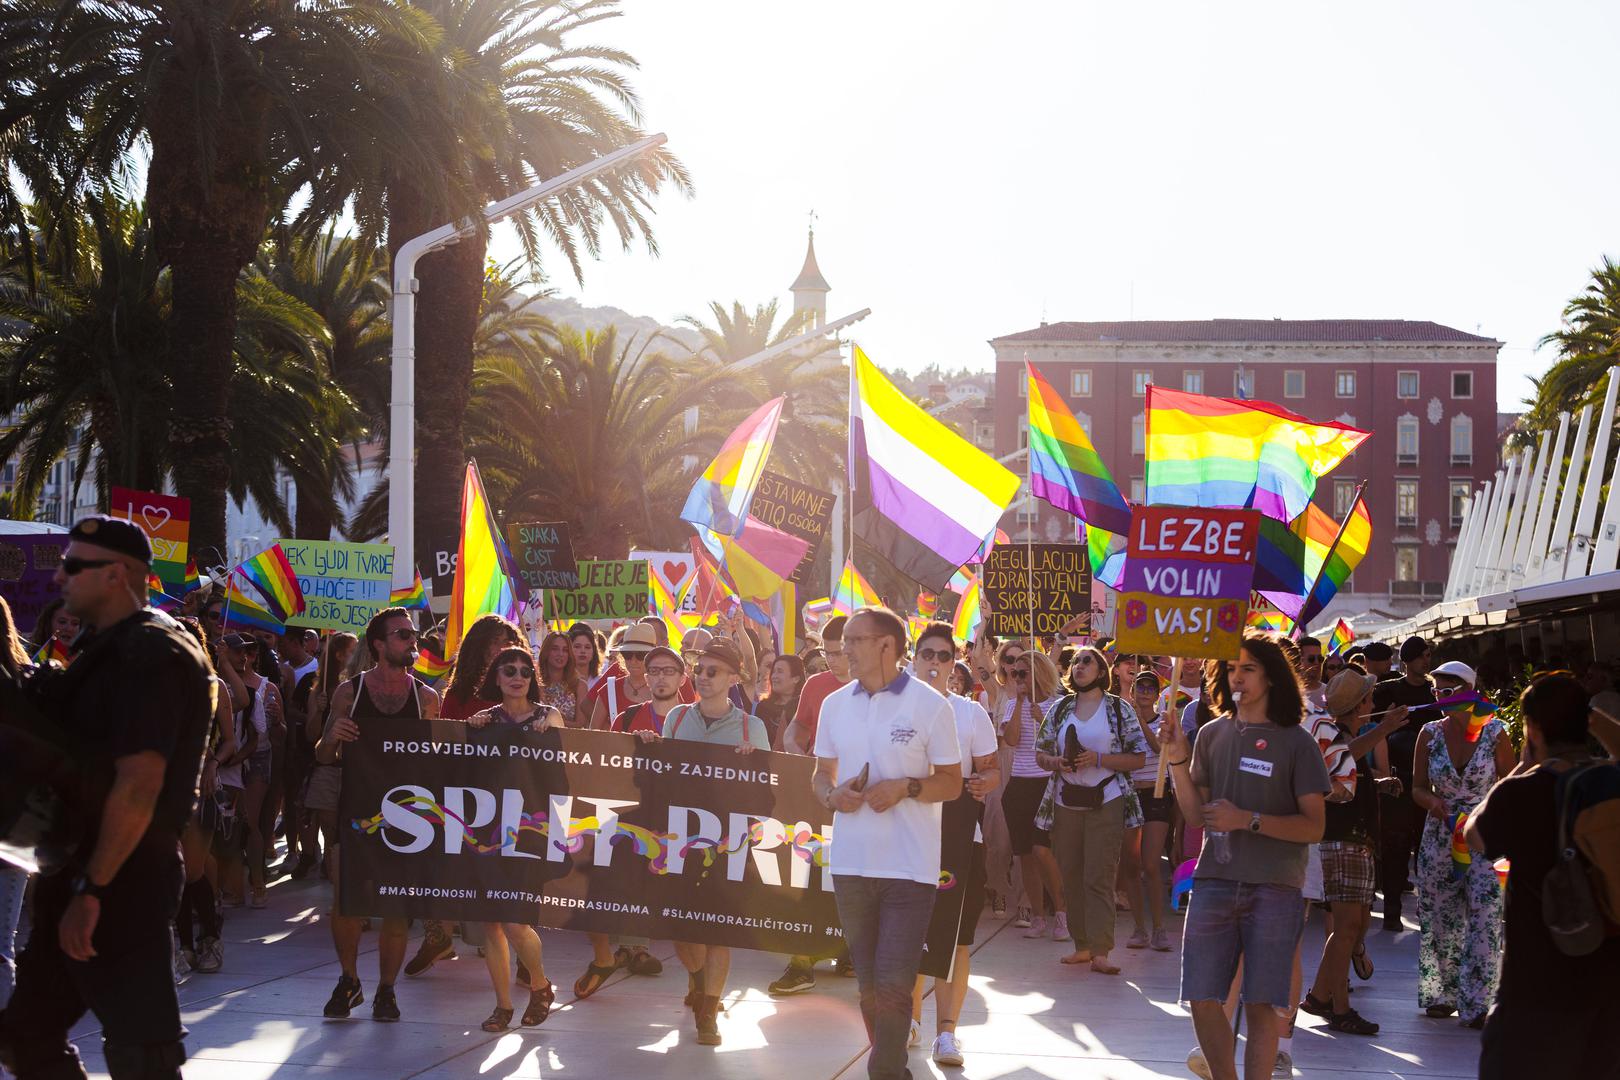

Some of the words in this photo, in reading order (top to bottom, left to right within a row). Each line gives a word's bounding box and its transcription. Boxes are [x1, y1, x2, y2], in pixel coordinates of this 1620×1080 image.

[520, 527, 560, 545] SVAKA
[788, 513, 822, 537] OSOBA
[152, 537, 179, 560] SY
[1138, 517, 1251, 561] LEZBE,
[315, 548, 349, 576] LJUDI
[354, 551, 394, 575] TVRDE
[525, 546, 556, 566] ČAST
[990, 550, 1085, 573] REGULACIJU
[520, 569, 579, 589] PEDERIMA
[575, 562, 625, 589] UEER
[629, 562, 648, 586] JE
[987, 571, 1089, 595] ZDRAVSTVENE
[1143, 566, 1222, 597] VOLIN
[315, 576, 355, 600] HOĆE
[550, 592, 619, 617] DOBAR
[998, 591, 1042, 610] SKRBI
[1049, 591, 1072, 611] ZA
[342, 604, 380, 627] JESA
[991, 611, 1032, 634] TRANS
[1154, 606, 1213, 643] VAS!
[383, 740, 501, 757] PROSVJEDNA
[509, 745, 593, 766] POVORKA
[600, 754, 673, 775] LGBTIQ+
[680, 762, 780, 787] ZAJEDNICE
[380, 784, 640, 867] SPLIT
[379, 886, 477, 899] #MASUPONOSNI
[486, 890, 650, 916] #KONTRAPREDRASUDAMA
[662, 907, 813, 934] #SLAVIMORAZLIČITOSTI
[825, 926, 846, 939] #N
